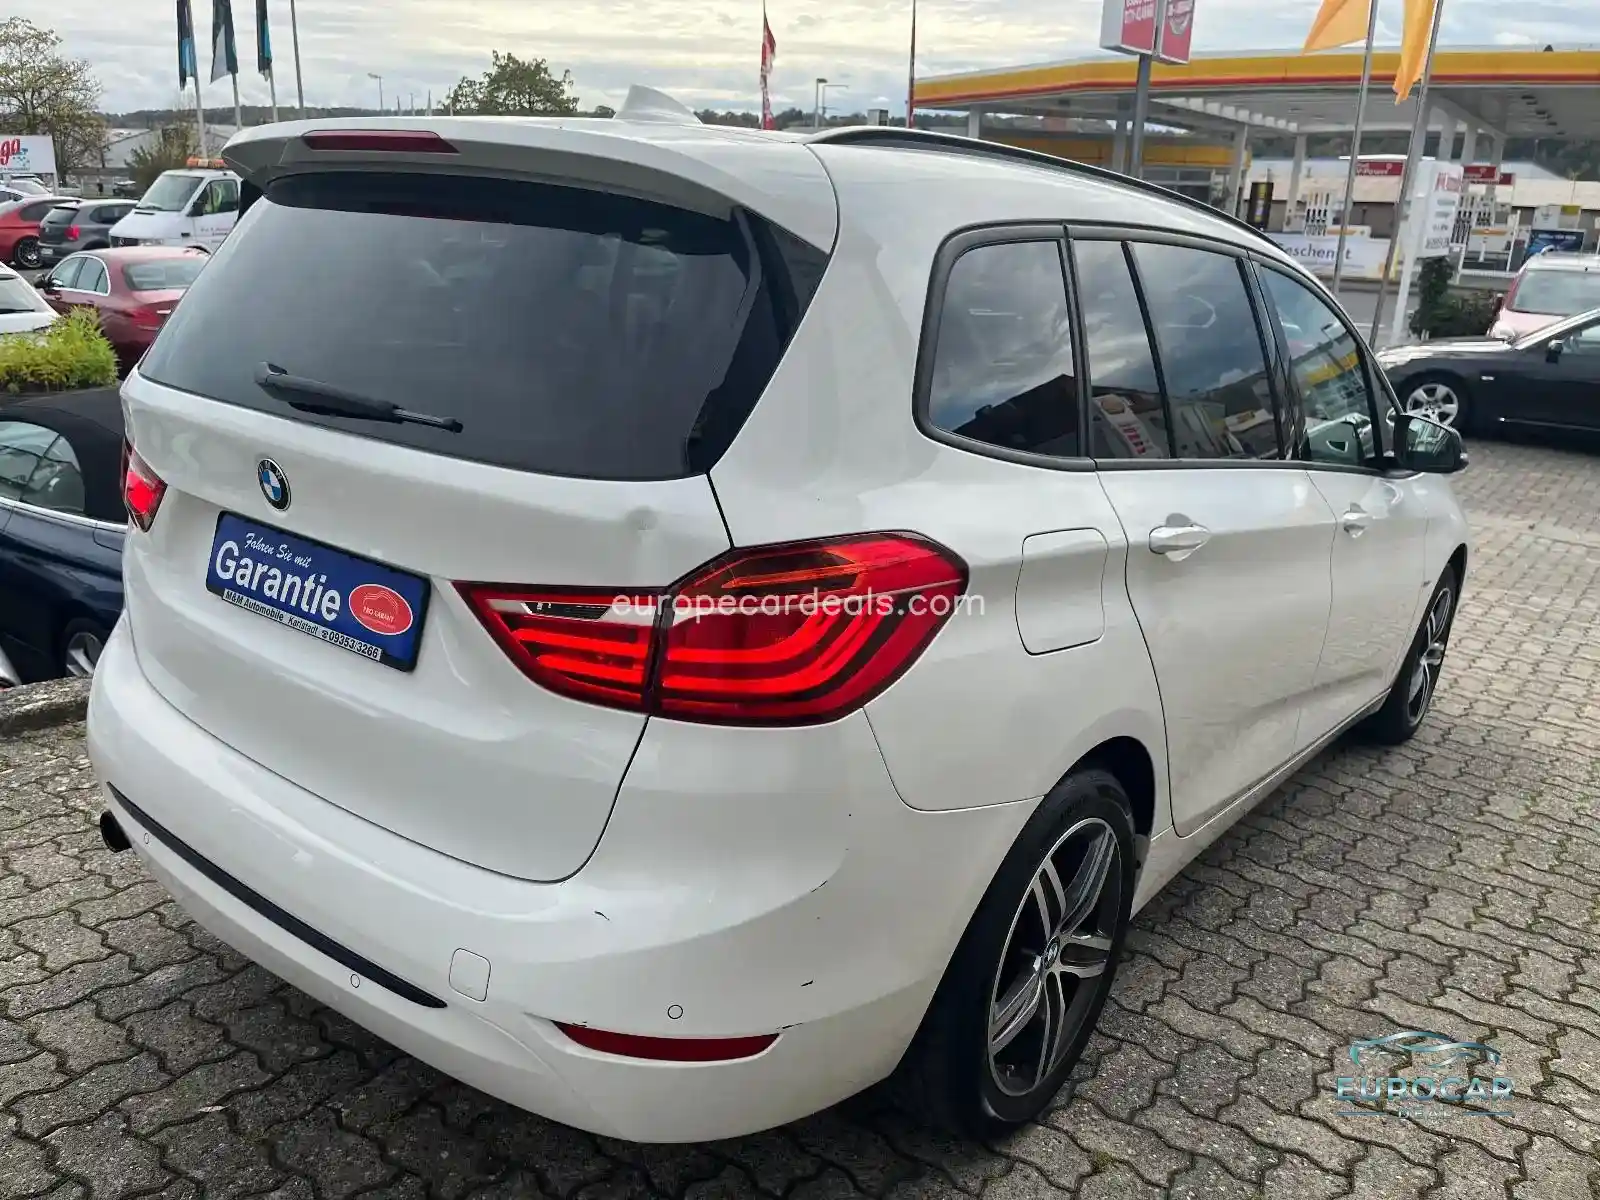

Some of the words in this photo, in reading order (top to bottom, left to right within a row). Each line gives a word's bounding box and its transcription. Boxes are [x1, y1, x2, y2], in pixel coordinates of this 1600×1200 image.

[1279, 243, 1352, 260] eschent
[245, 533, 274, 555] Fahren
[276, 544, 292, 562] Sie
[294, 556, 312, 568] mit
[216, 540, 341, 622] Garantie
[225, 590, 242, 605] M&M
[243, 598, 284, 621] Automobile
[287, 616, 319, 635] Karlstadt
